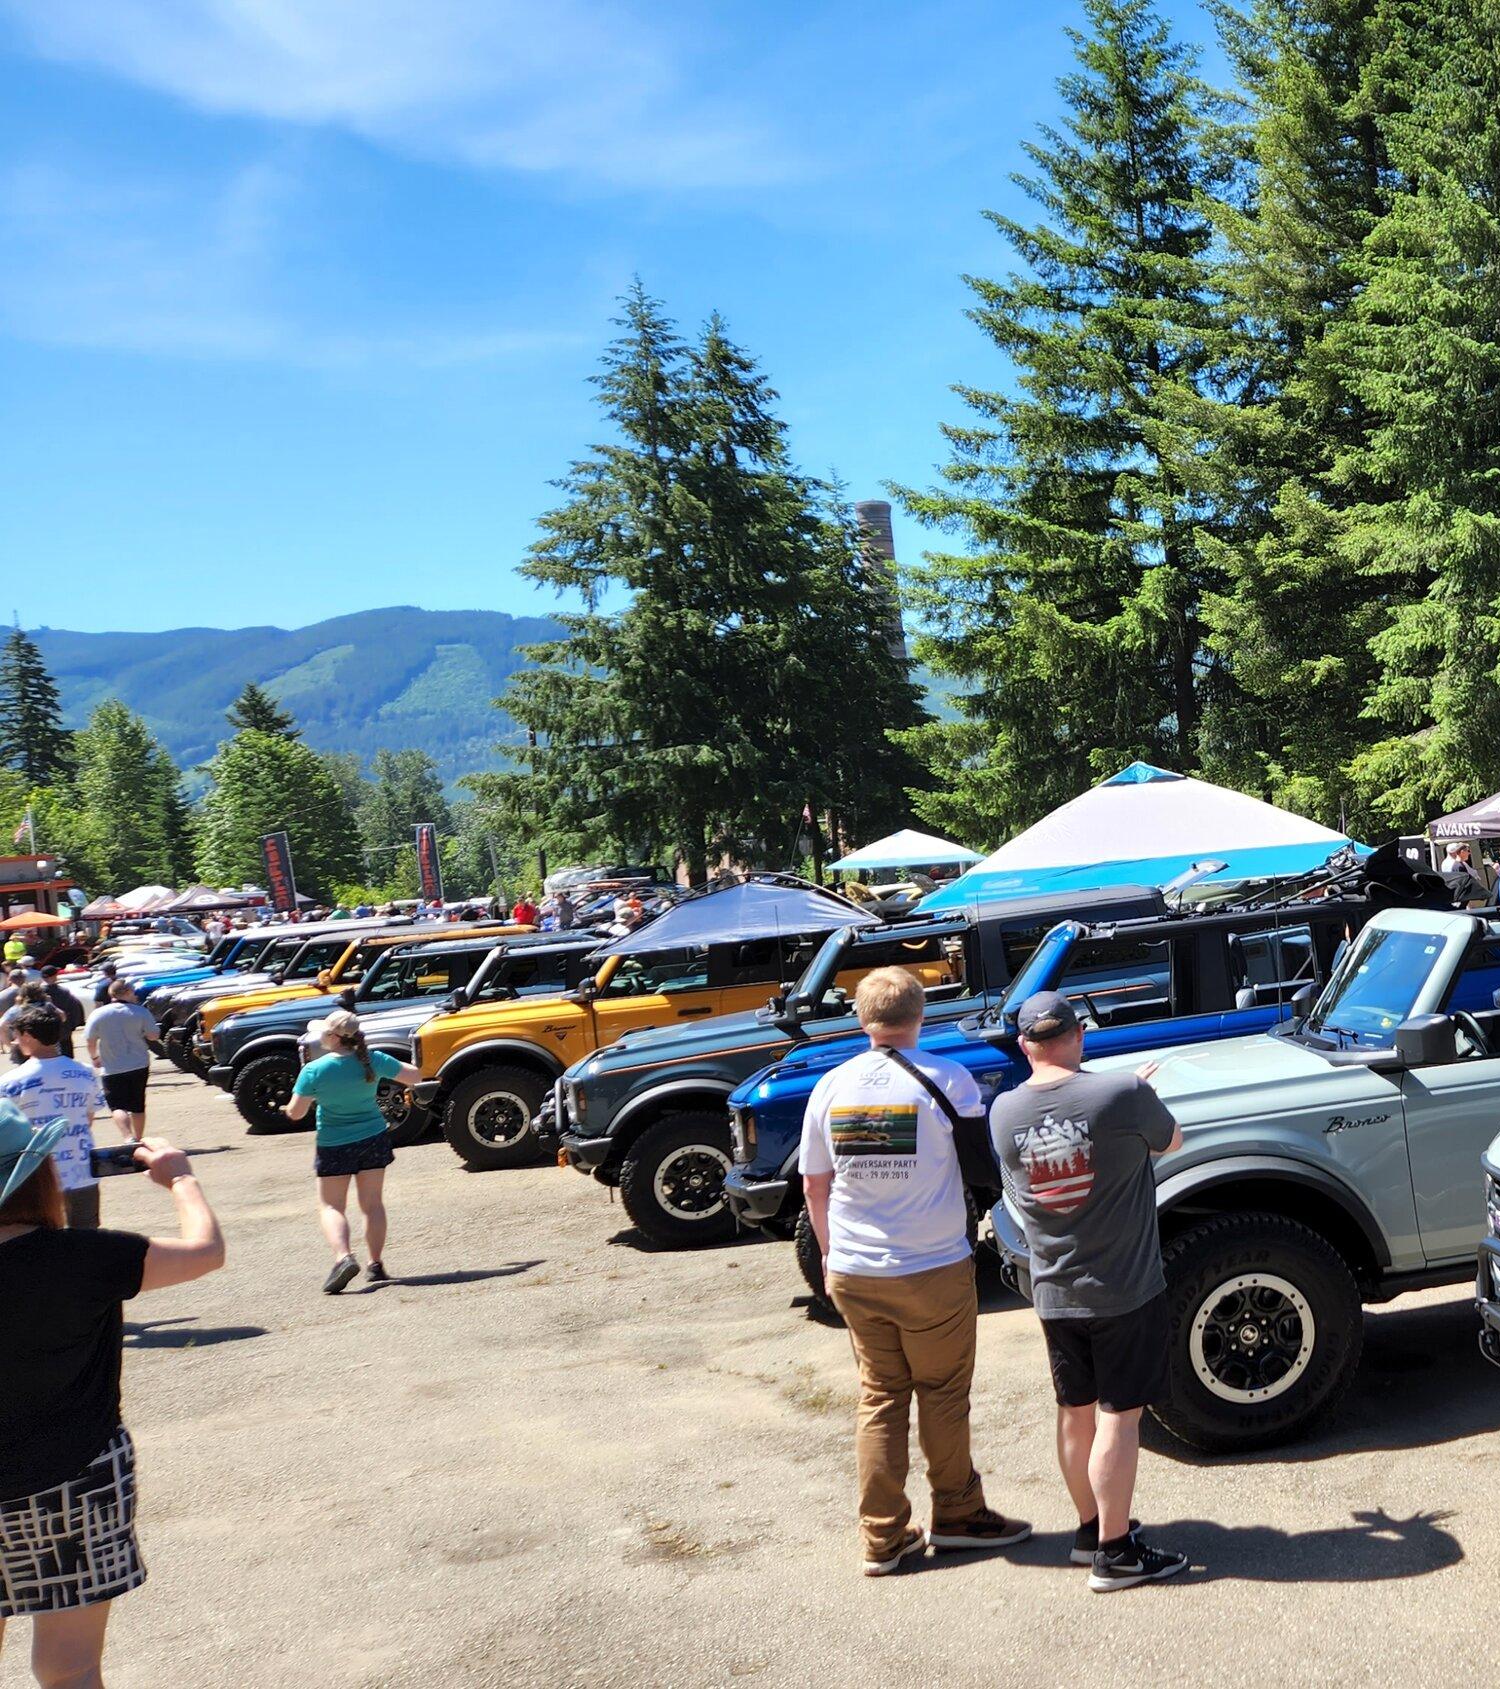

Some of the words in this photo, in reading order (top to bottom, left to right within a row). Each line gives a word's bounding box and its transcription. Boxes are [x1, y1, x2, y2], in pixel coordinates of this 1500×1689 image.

[1435, 822, 1482, 836] AVANTS
[1322, 1116, 1392, 1133] Bronco
[893, 1159, 918, 1169] PARTY
